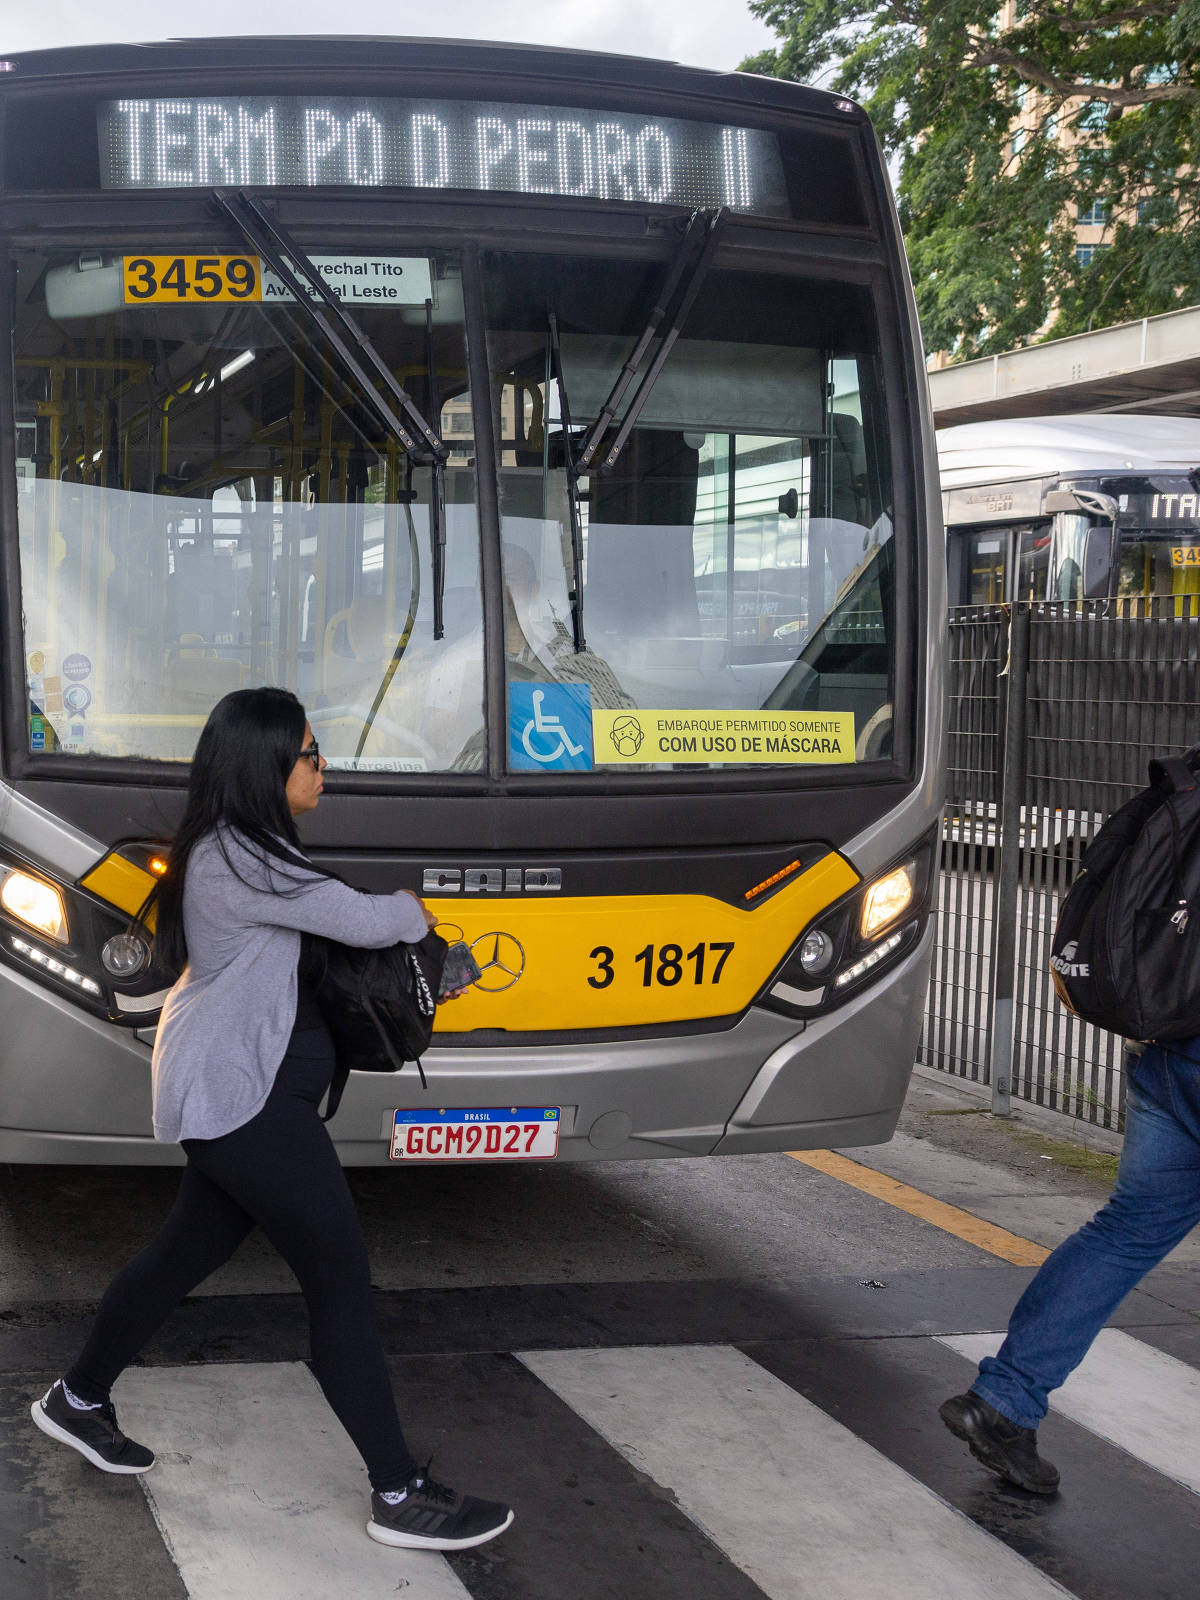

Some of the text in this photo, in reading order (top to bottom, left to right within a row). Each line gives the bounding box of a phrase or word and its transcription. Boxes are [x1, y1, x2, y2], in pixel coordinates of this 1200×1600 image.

[118, 100, 276, 186] TERM
[411, 113, 449, 188] D
[477, 116, 673, 203] PEDRO
[127, 258, 257, 299] 3459
[371, 263, 404, 276] Tito
[265, 283, 290, 297] Av.
[353, 284, 398, 298] Leste
[1151, 494, 1200, 518] ITA
[1174, 549, 1200, 564] 34
[657, 719, 841, 733] EMBARQUE PERMITIDO SOMENTE
[658, 734, 842, 753] COM USO DE MÁSCARA
[423, 868, 562, 892] CAIO
[587, 942, 735, 989] 3 1817
[464, 1113, 491, 1121] BRASIL
[406, 1124, 540, 1154] GCM9D27
[394, 1148, 404, 1157] BR
